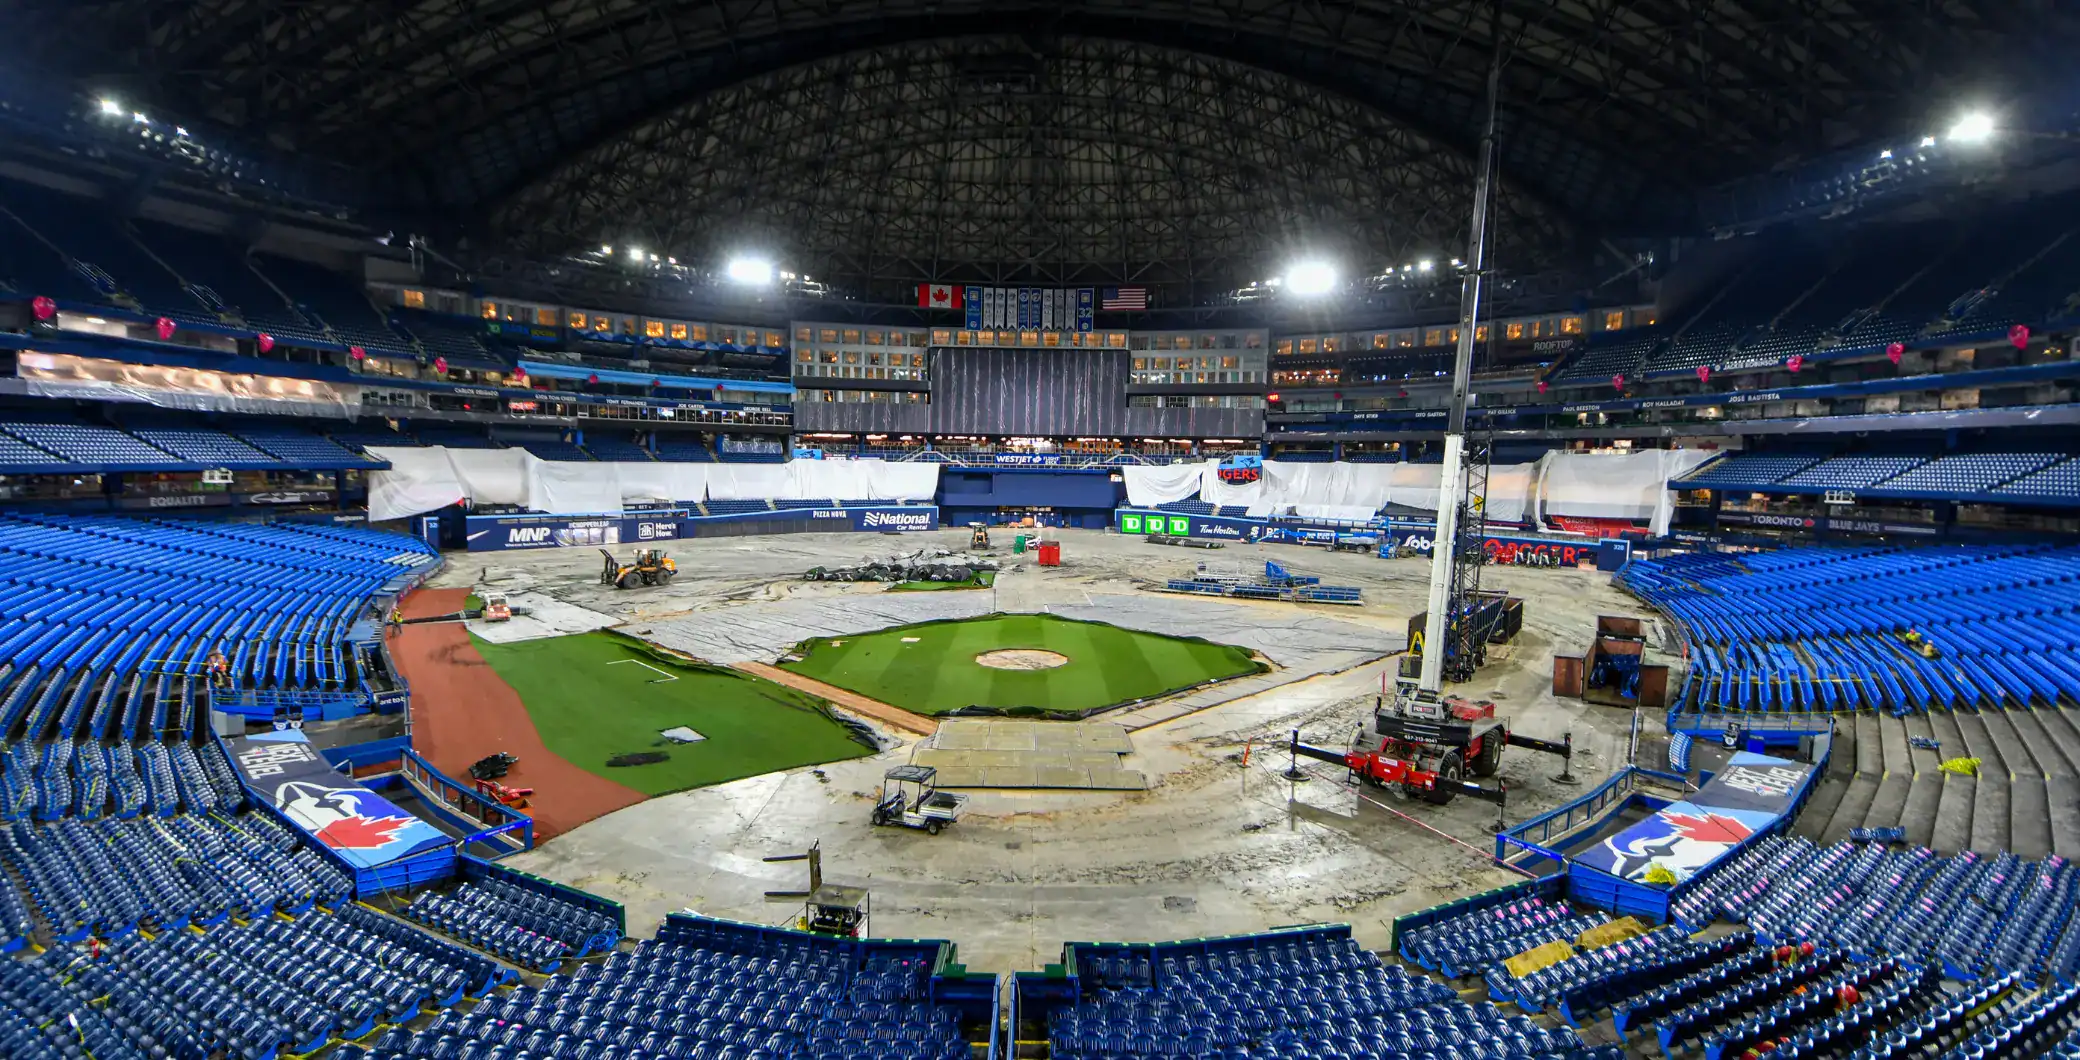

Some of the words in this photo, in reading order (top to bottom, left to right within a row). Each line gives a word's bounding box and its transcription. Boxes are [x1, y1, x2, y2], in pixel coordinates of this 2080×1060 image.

[1078, 307, 1092, 318] 32
[1534, 340, 1574, 351] ROOFTOP
[1745, 358, 1779, 368] ROBINSON
[1747, 393, 1780, 402] BAUTISTA
[996, 455, 1033, 465] WESTJET
[150, 495, 206, 507] EQUALITY
[813, 510, 830, 518] PIZZA
[831, 510, 847, 518] NOVA
[655, 522, 676, 531] Here's
[1124, 517, 1140, 530] TD
[1147, 518, 1163, 531] TD
[1171, 519, 1187, 532] TD
[1752, 515, 1803, 527] TORONTO
[1829, 519, 1854, 530] BLUE
[1855, 521, 1880, 532] JAYS
[509, 527, 551, 543] MNP
[655, 530, 673, 538] Now.
[1200, 524, 1213, 534] Tim
[1213, 525, 1240, 535] Hortons
[265, 742, 310, 762] NEXT
[237, 753, 285, 780] LEVEL
